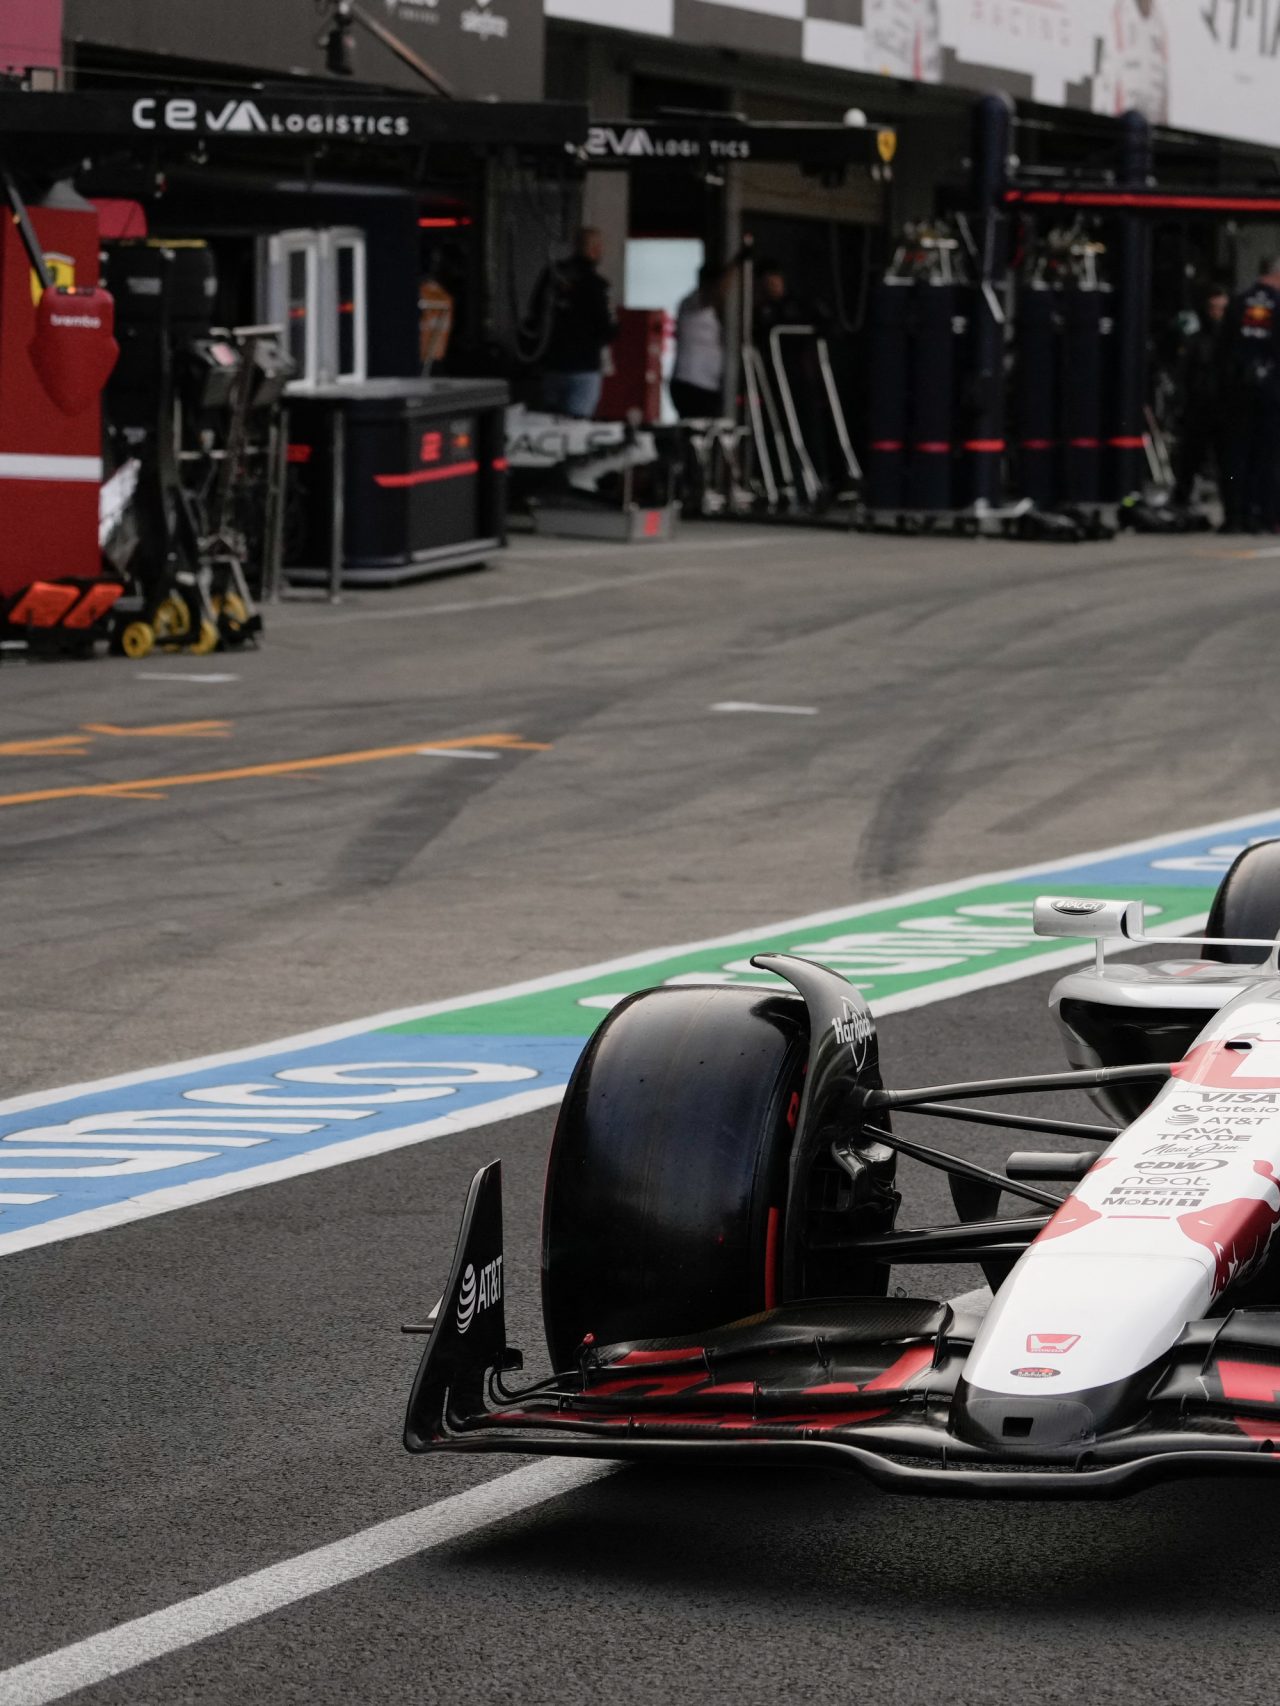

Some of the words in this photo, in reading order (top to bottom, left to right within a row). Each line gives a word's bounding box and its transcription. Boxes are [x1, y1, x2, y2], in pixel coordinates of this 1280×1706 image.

[272, 115, 410, 137] LOGISTICS
[587, 127, 654, 156] EVA
[655, 139, 750, 158] LOGITICS
[1065, 901, 1098, 910] RAUCH
[1201, 1093, 1277, 1103] VISA
[1196, 1105, 1280, 1113] Gate.io
[1203, 1117, 1271, 1125] AT&T
[1157, 1133, 1252, 1141] TRADE
[1134, 1161, 1207, 1170] CDW
[1101, 1197, 1174, 1206] Mobil
[477, 1255, 503, 1314] AT&T
